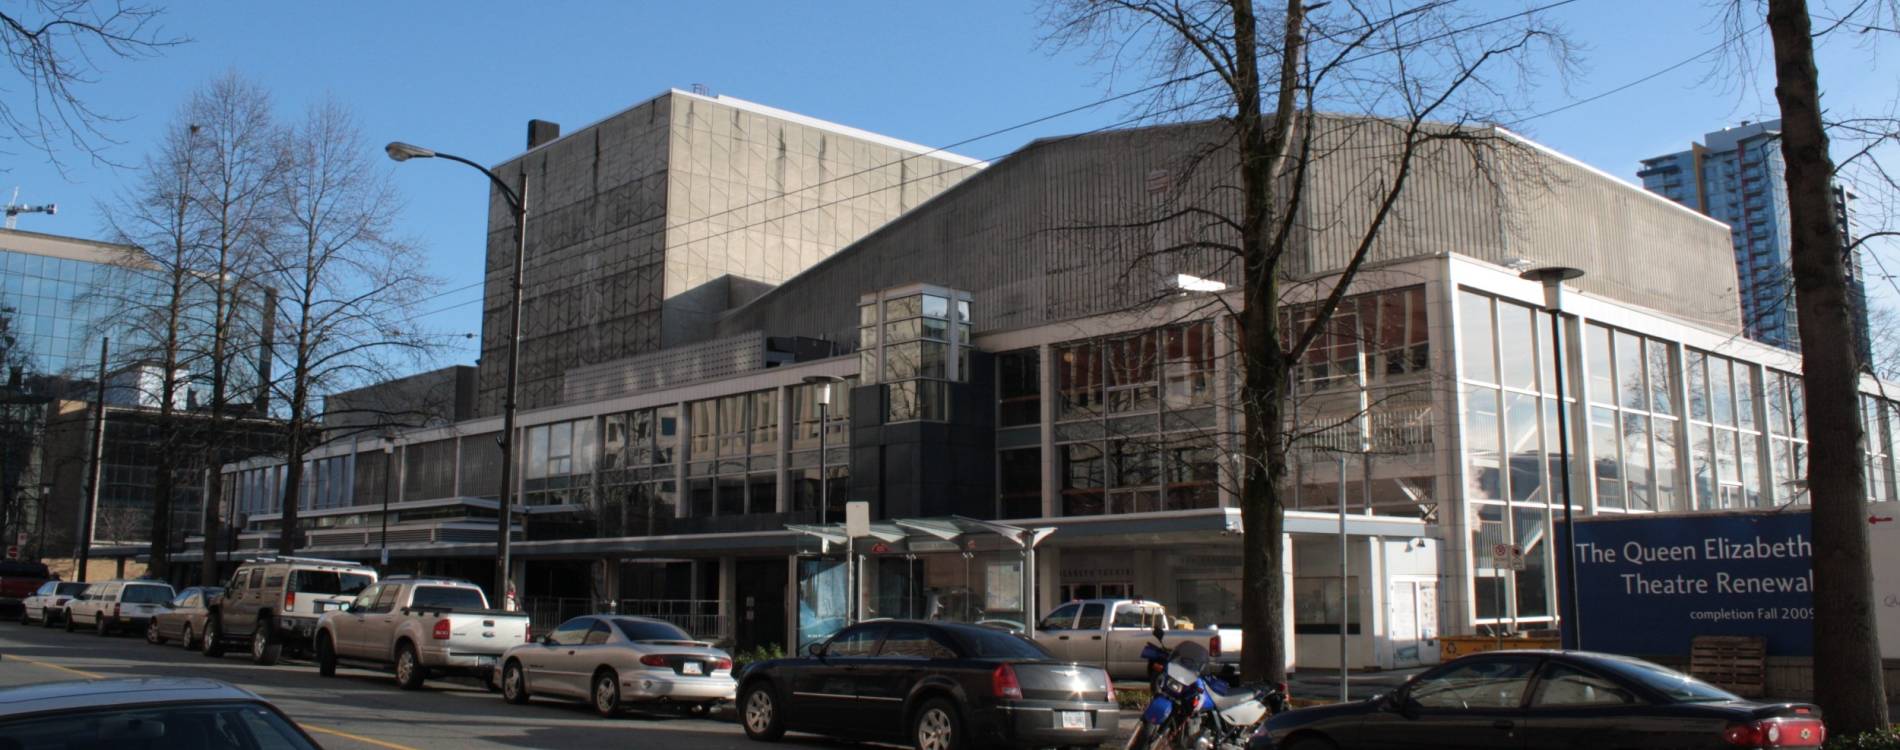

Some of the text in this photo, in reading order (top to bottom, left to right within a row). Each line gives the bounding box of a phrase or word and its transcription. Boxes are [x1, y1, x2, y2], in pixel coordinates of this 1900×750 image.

[1576, 534, 1813, 565] The Queen Elizabeth
[1621, 569, 1814, 594] Theatre Renewal
[1689, 607, 1754, 622] completion
[1757, 607, 1777, 620] Fall
